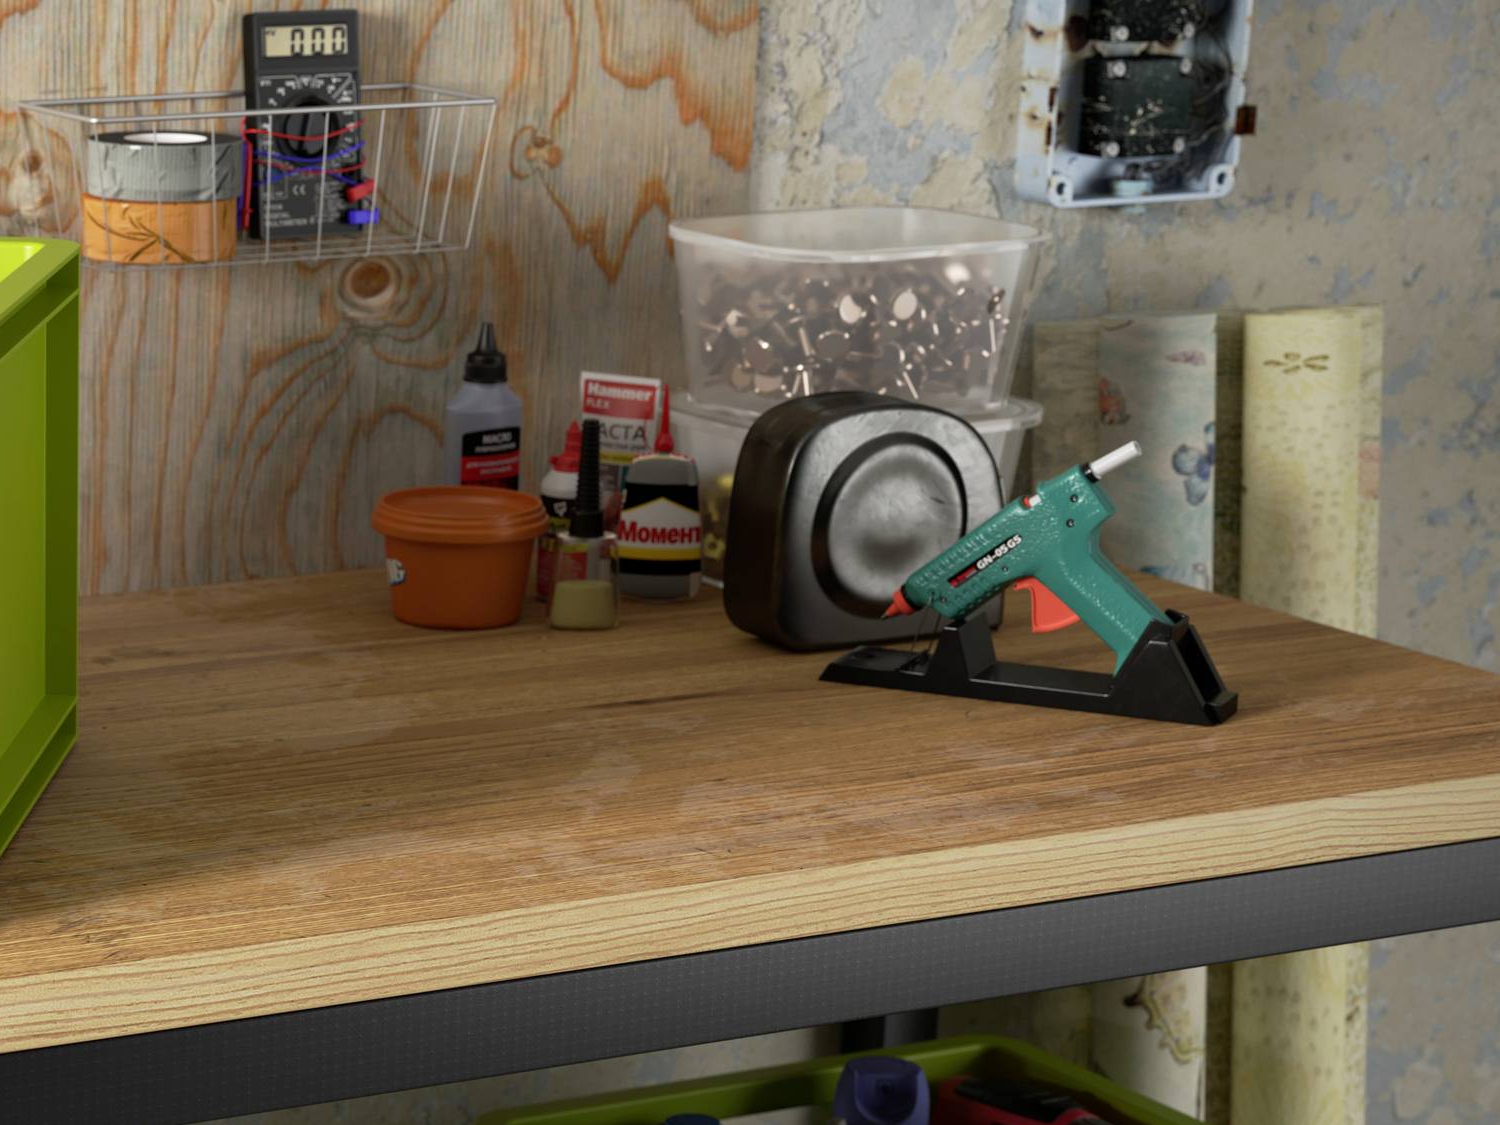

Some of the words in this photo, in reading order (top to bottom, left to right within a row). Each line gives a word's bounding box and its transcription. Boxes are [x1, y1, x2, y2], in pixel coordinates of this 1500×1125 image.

[587, 381, 654, 403] Hammer
[599, 421, 649, 444] АСТА
[617, 520, 701, 544] Момент
